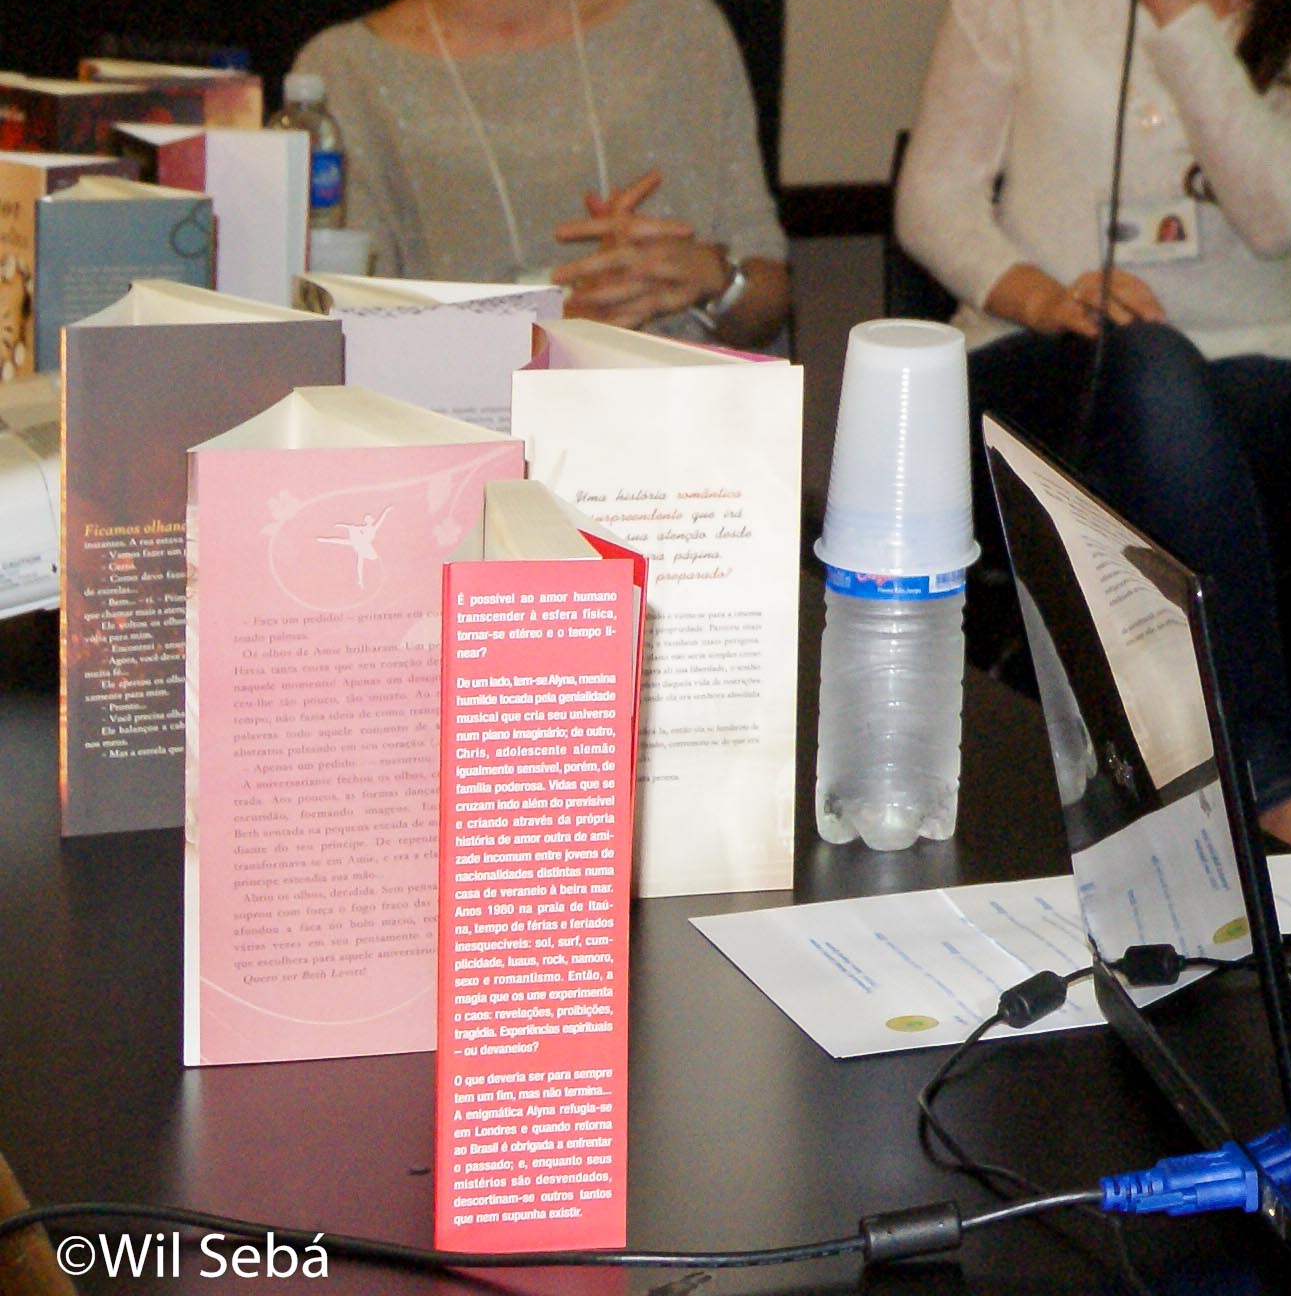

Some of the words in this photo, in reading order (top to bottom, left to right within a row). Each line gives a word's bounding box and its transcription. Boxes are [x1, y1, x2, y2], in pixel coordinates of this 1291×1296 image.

[576, 490, 607, 503] Uma
[615, 489, 667, 502] história
[83, 524, 140, 537] Ficamos
[456, 592, 464, 604] É
[469, 593, 515, 606] possível
[519, 594, 534, 602] ao
[539, 593, 568, 602] amor
[572, 591, 617, 601] humano
[456, 611, 525, 622] transcender
[541, 609, 577, 619] esfera
[582, 608, 617, 619] física,
[456, 630, 505, 640] tornar-se
[546, 629, 553, 637] e
[567, 626, 601, 638] tempo
[456, 647, 487, 658] near?
[456, 712, 499, 722] musical
[500, 713, 521, 722] que
[523, 710, 545, 720] cria
[546, 711, 567, 719] seu
[568, 708, 616, 719] universo
[481, 729, 510, 741] piano
[512, 727, 568, 740] imaginário;
[570, 727, 584, 736] de
[585, 726, 616, 737] outro,
[455, 747, 489, 759] Chris,
[495, 745, 567, 756] adolescente
[572, 743, 615, 753] alemão
[455, 782, 492, 793] família
[494, 781, 545, 793] poderosa.
[548, 779, 577, 789] Vidas
[579, 780, 600, 790] que
[466, 817, 508, 828] criando
[512, 815, 553, 826] através
[557, 814, 571, 824] da
[575, 813, 615, 825] própria
[454, 906, 482, 916] Anos
[518, 905, 532, 913] na
[536, 902, 565, 914] praia
[569, 901, 583, 911] de
[454, 925, 472, 934] na,
[473, 923, 509, 934] tempo
[510, 921, 524, 931] de
[526, 919, 558, 930] férias
[569, 917, 614, 928] feriados
[454, 938, 531, 952] inesquecíveis:
[534, 937, 554, 948] sol,
[557, 936, 582, 947] surf,
[584, 936, 613, 945] cum-
[454, 977, 479, 986] sexo
[493, 972, 563, 984] romantismo.
[567, 969, 602, 981] Então,
[463, 1011, 492, 1020] caos:
[556, 1003, 613, 1017] proibições,
[453, 1075, 462, 1085] O
[464, 1076, 485, 1086] que
[486, 1072, 526, 1083] deveria
[527, 1072, 545, 1081] ser
[546, 1071, 571, 1081] para
[572, 1069, 613, 1080] sempre
[453, 1110, 462, 1119] A
[465, 1107, 523, 1121] enigmática
[525, 1105, 555, 1117] Alyna
[558, 1101, 612, 1116] refugia-se
[453, 1177, 507, 1189] mistérios
[510, 1175, 531, 1185] são
[535, 1171, 612, 1185] desvendados,
[452, 1192, 535, 1206] descortinam-se
[540, 1191, 574, 1201] outros
[579, 1188, 612, 1199] tantos
[452, 1215, 474, 1226] que
[475, 1213, 499, 1222] nem
[501, 1208, 547, 1222] supunha
[548, 1206, 582, 1218] existir.
